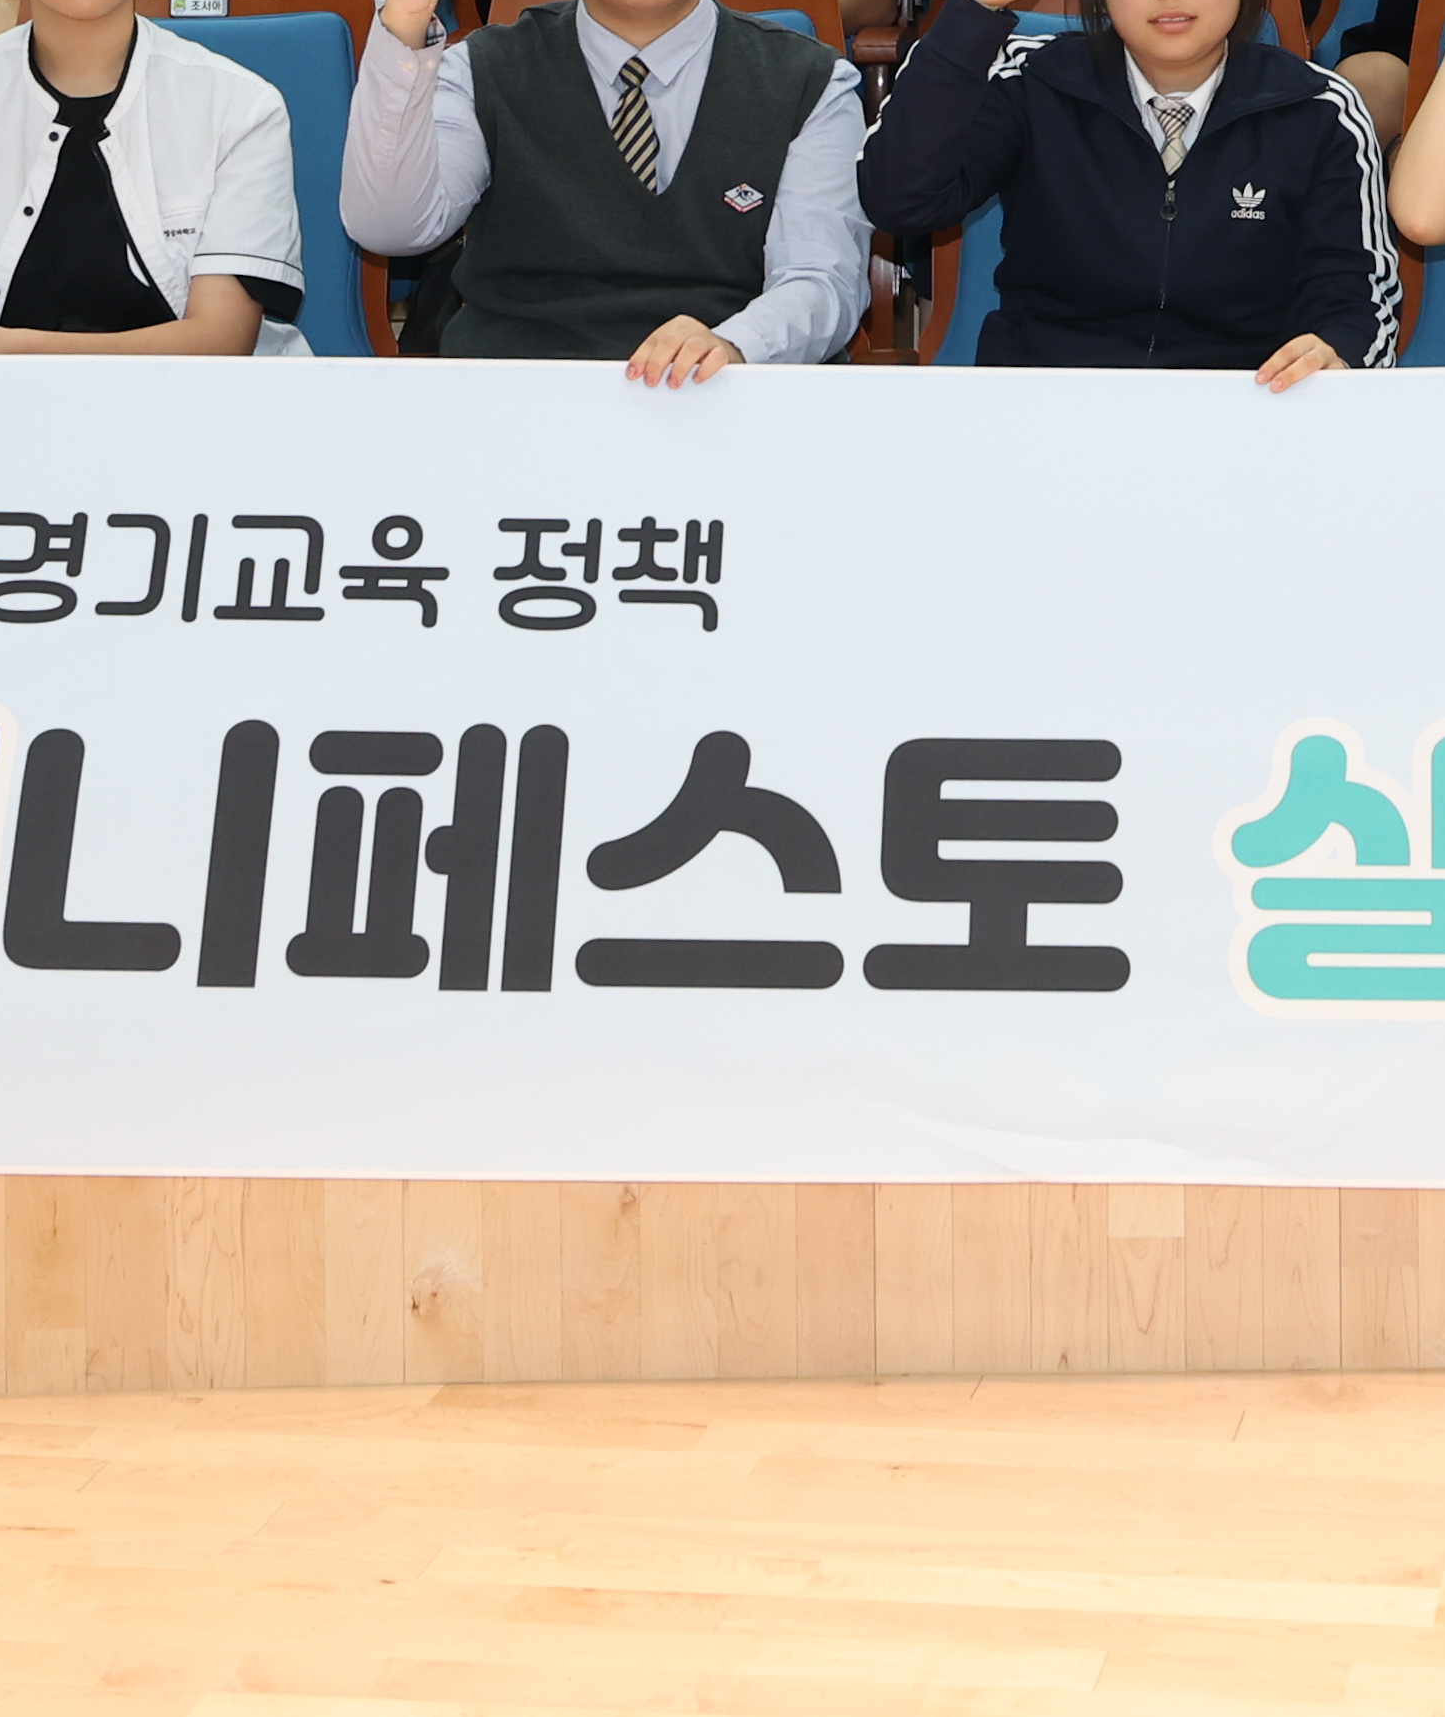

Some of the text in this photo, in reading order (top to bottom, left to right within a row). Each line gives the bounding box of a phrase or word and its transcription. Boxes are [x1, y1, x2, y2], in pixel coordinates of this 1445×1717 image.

[190, 0, 221, 12] 조서아
[1231, 208, 1266, 221] adidas
[493, 515, 725, 633] 정책
